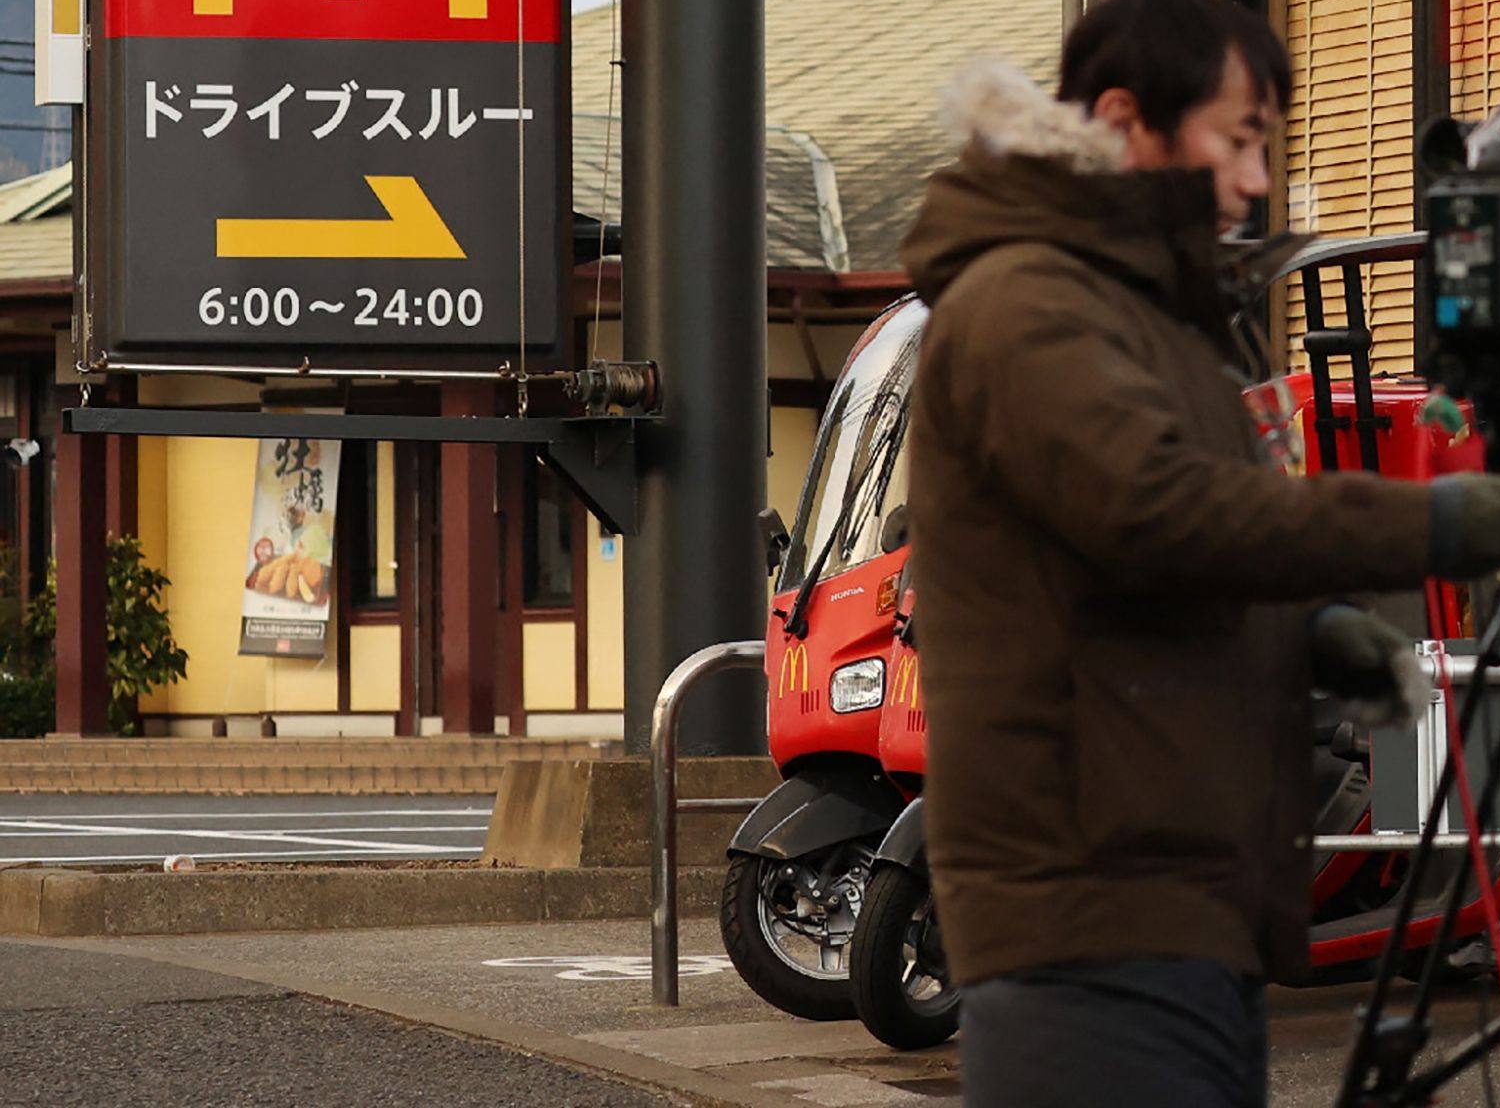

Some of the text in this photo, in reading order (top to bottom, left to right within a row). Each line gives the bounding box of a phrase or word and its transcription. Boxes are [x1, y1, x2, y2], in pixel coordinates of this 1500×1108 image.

[145, 80, 534, 141] ドライブスルー
[830, 586, 865, 602] HONDA
